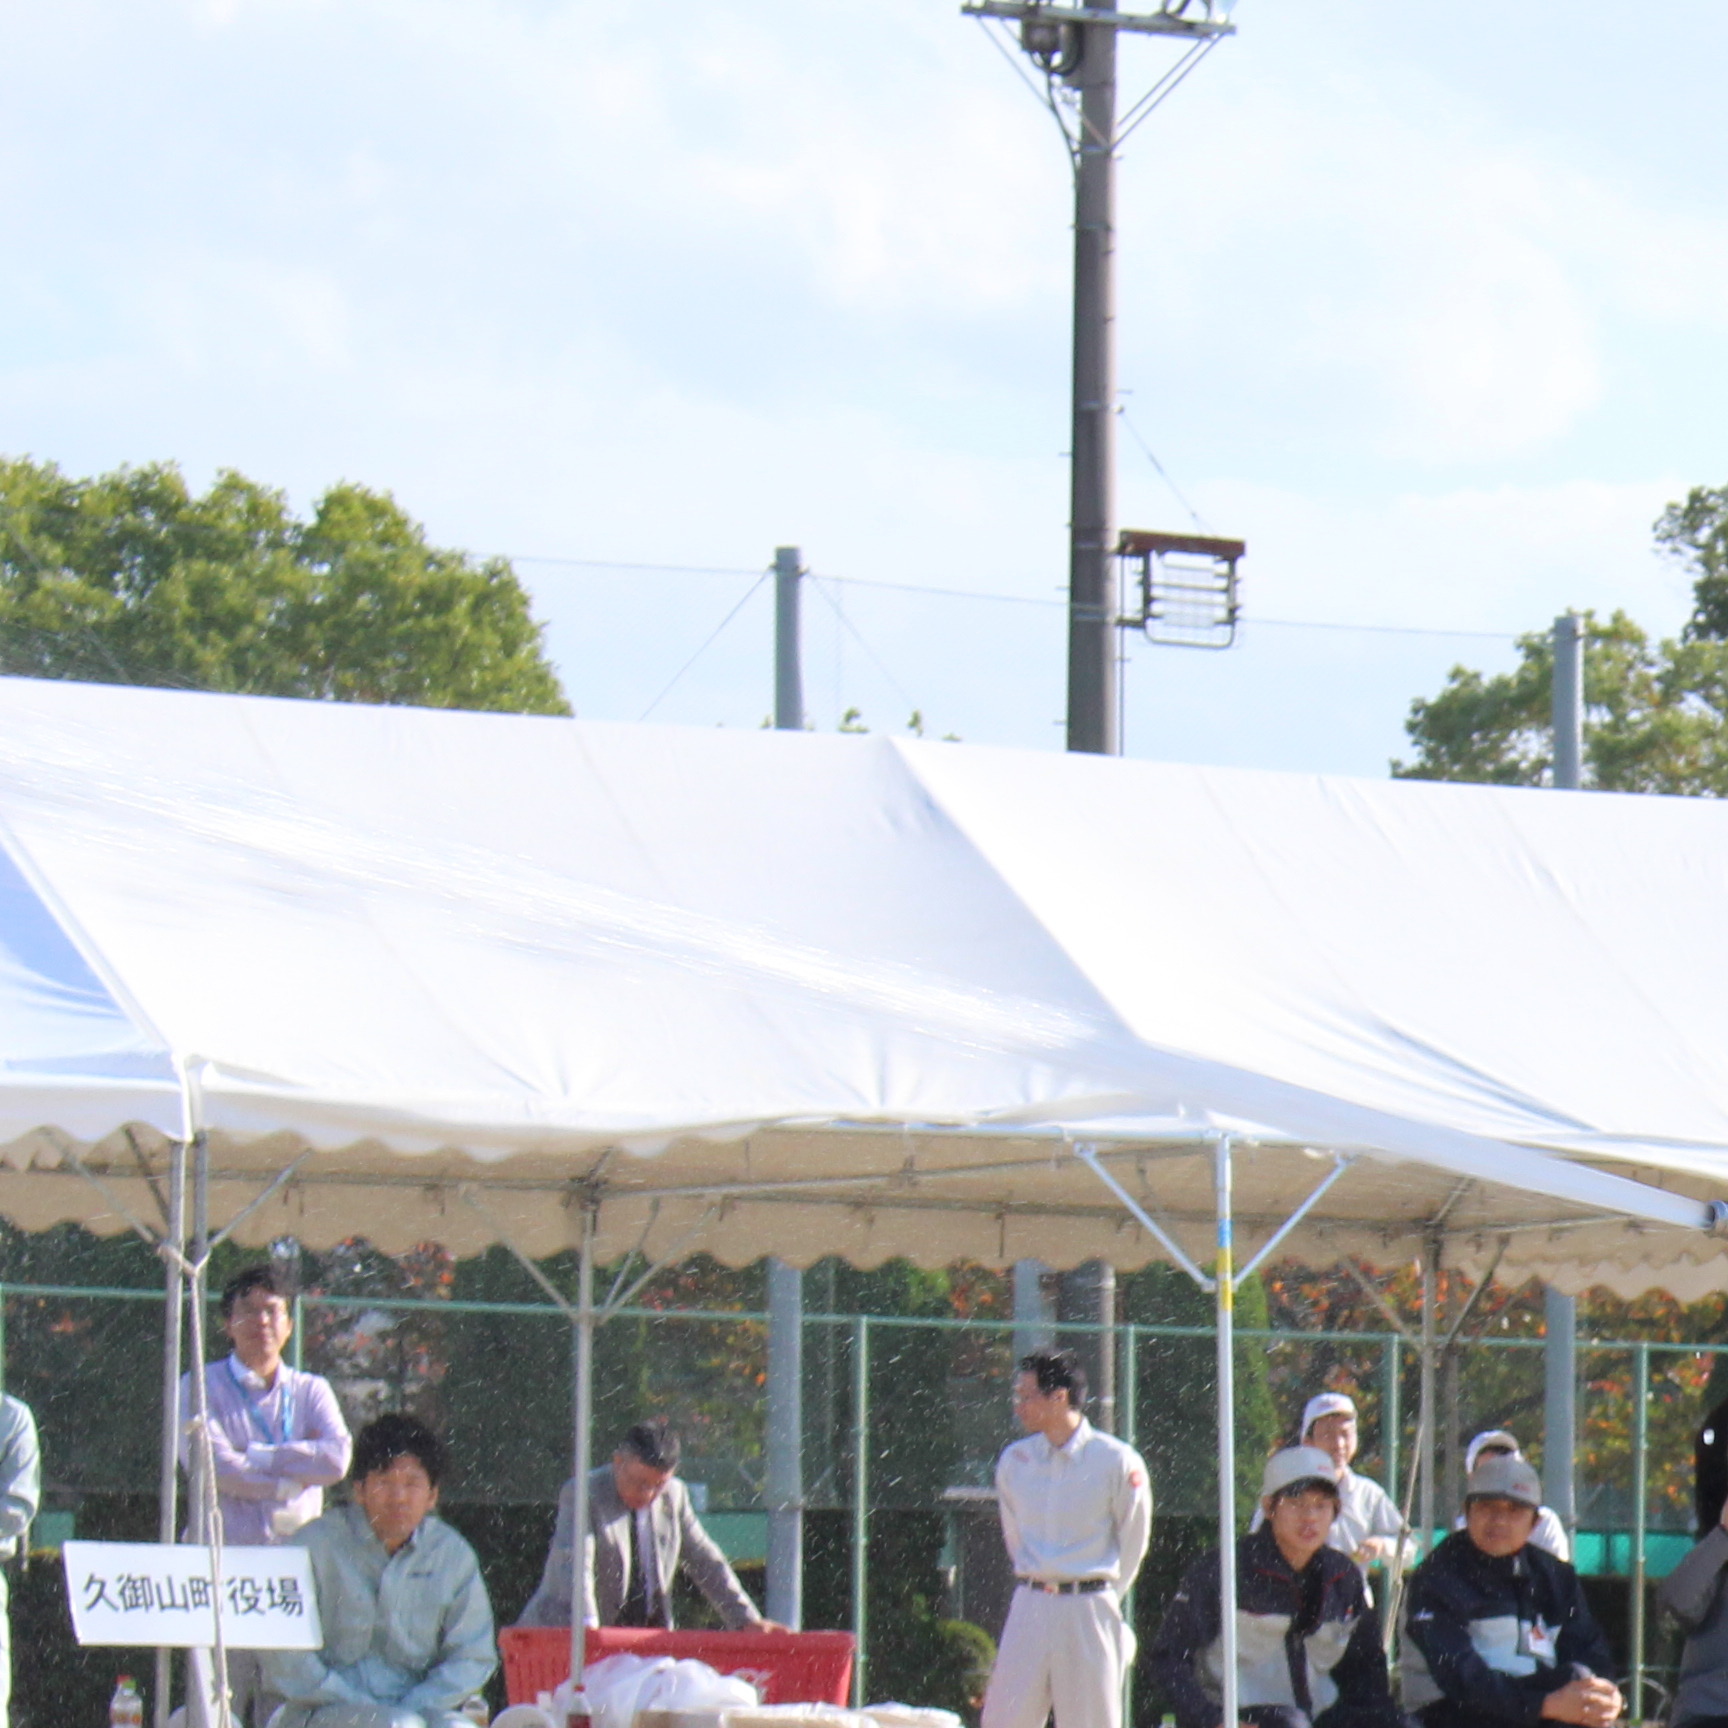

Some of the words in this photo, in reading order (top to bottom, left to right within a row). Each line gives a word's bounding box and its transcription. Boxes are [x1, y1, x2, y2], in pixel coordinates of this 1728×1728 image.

[83, 1572, 304, 1617] 久御山町役場
